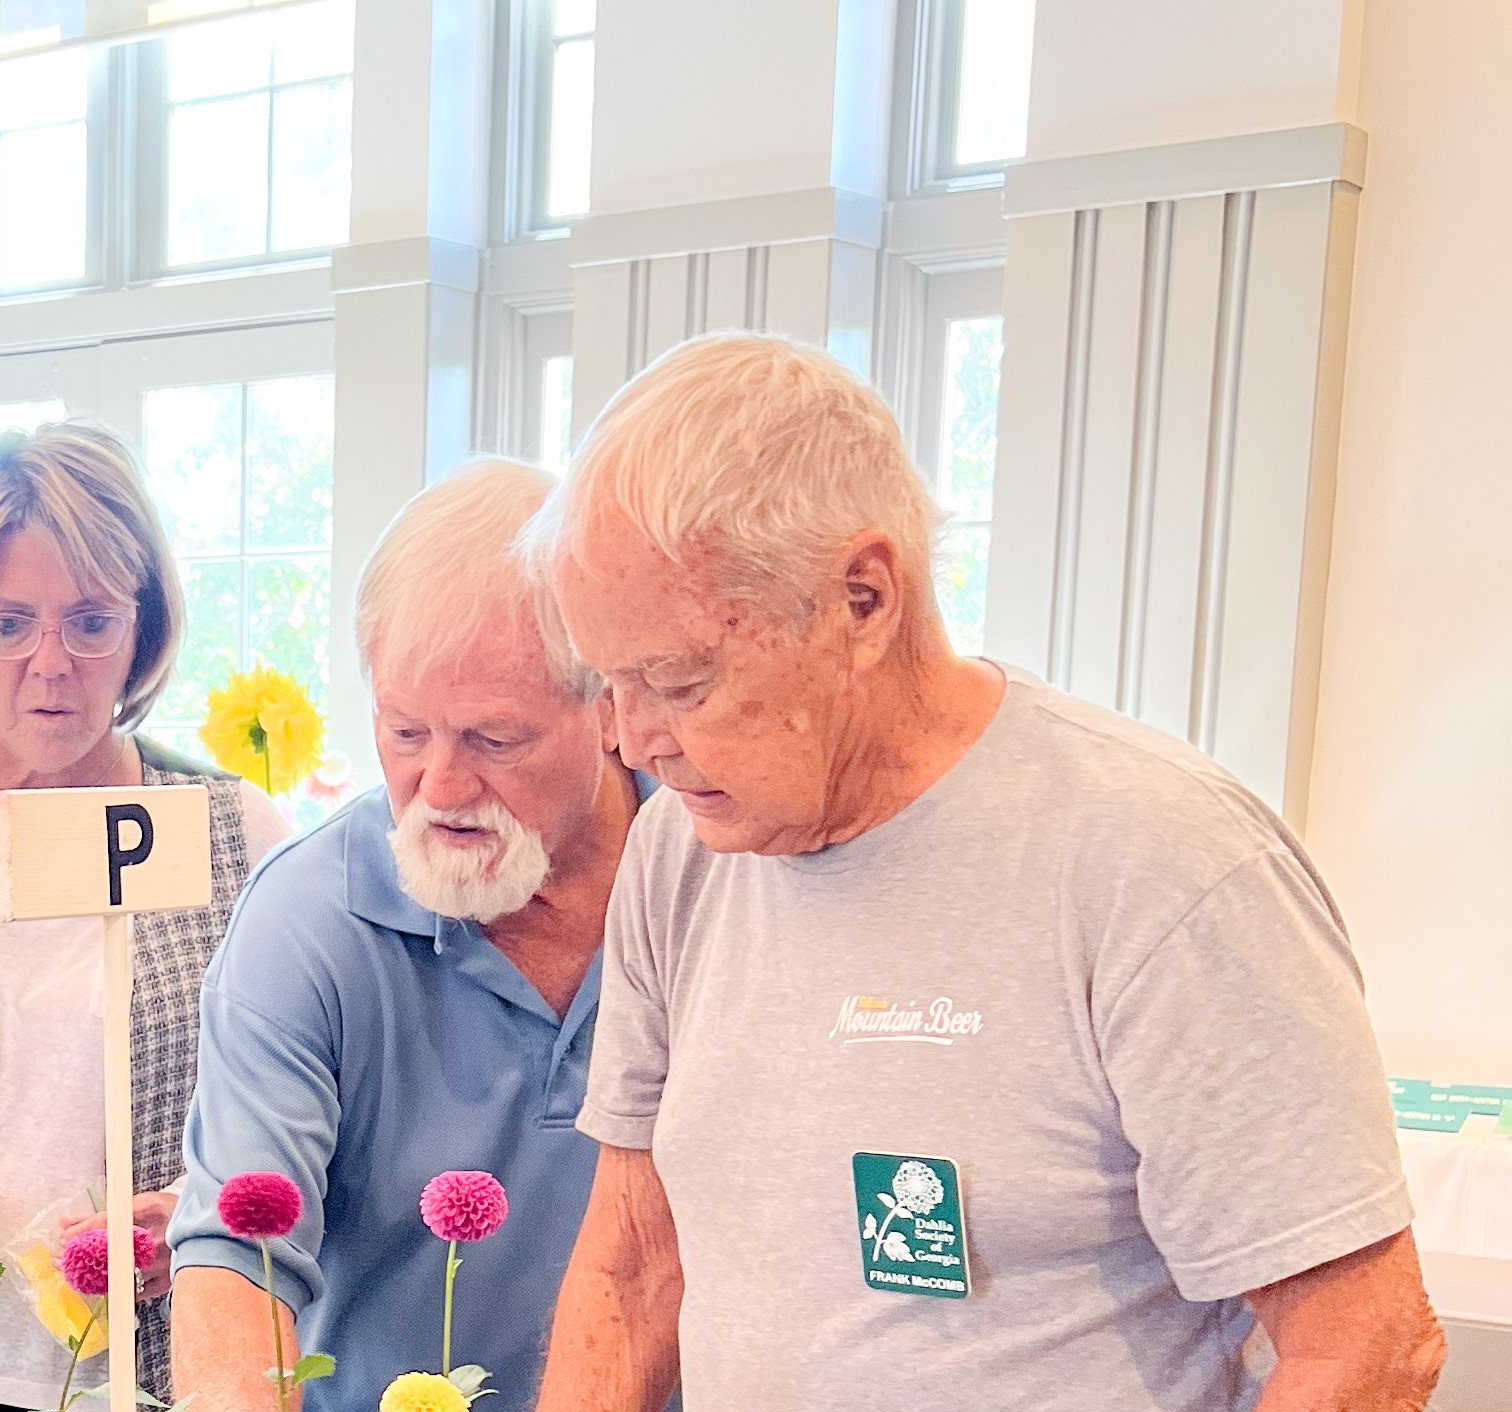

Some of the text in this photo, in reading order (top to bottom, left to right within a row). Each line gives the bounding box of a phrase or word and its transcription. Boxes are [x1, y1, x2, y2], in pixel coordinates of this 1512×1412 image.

[105, 803, 154, 906] P
[829, 995, 984, 1038] Mountain Beer
[869, 1270, 911, 1286] FRANK
